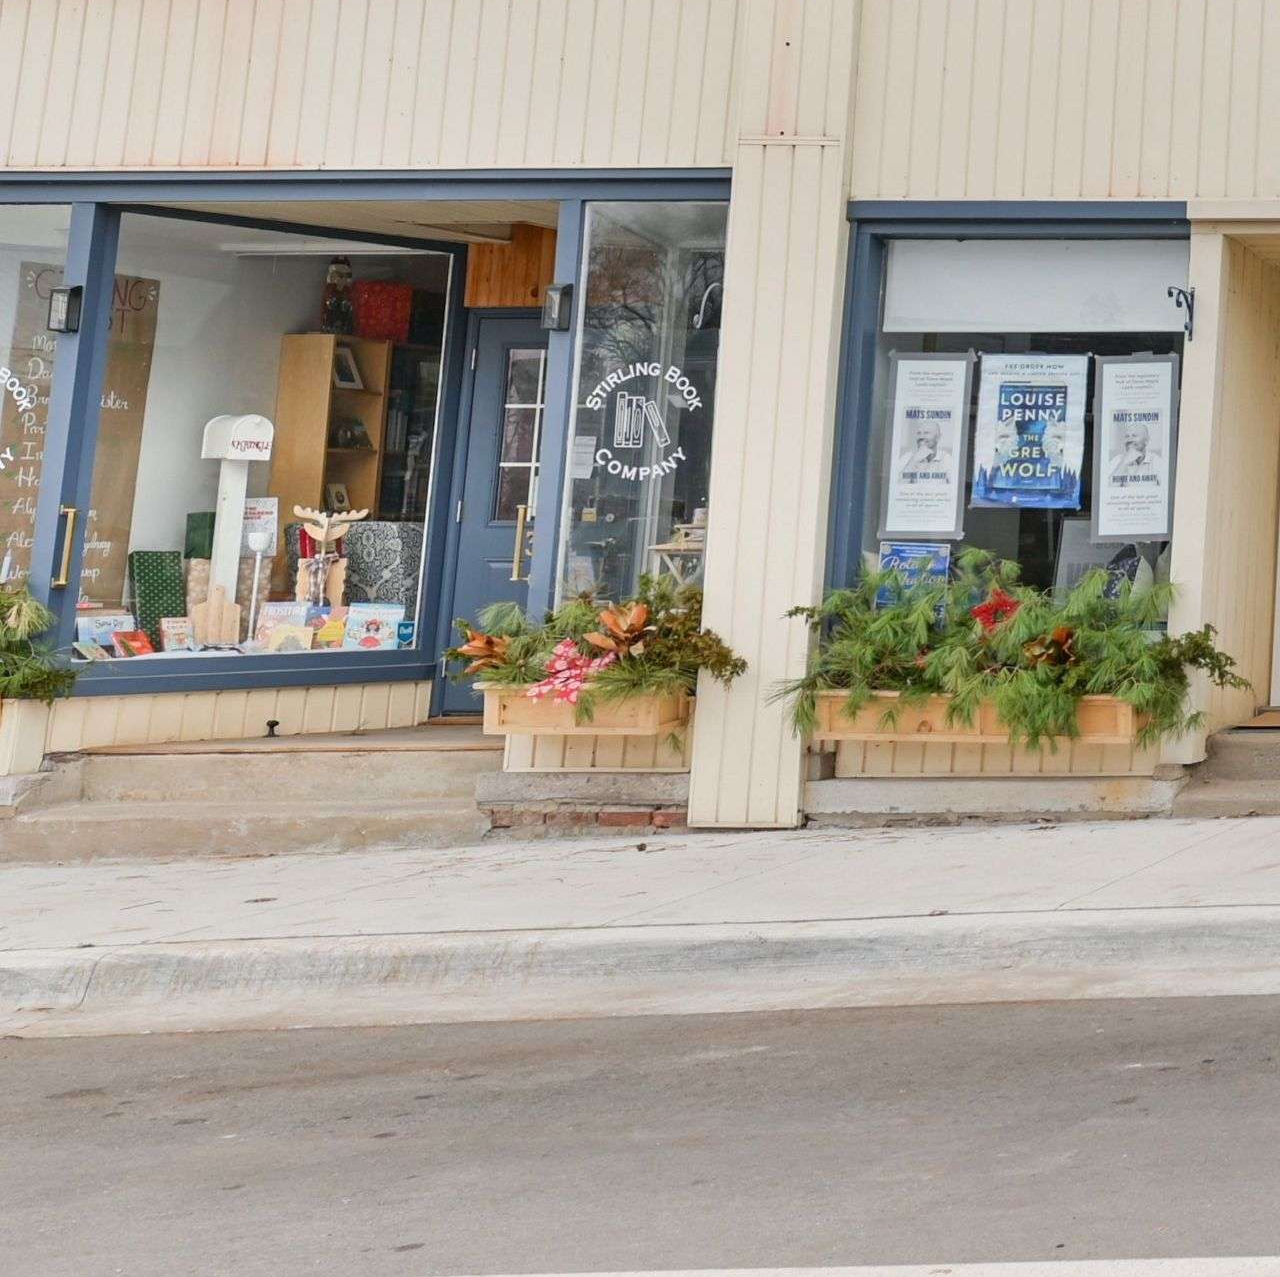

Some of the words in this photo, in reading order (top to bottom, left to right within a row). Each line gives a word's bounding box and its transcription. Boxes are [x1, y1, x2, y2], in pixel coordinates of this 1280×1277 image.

[585, 362, 661, 411] STIRLING
[664, 366, 703, 411] BOOK
[1001, 393, 1065, 406] LOUISE
[905, 409, 925, 420] MATS
[926, 409, 952, 420] SUNDIN
[1002, 408, 1063, 422] PENNY
[1113, 412, 1132, 422] MATS
[1133, 411, 1160, 422] SUNDIN
[1023, 434, 1040, 442] THE
[1008, 446, 1051, 458] GREY
[595, 446, 687, 480] COMPANY
[1000, 462, 1058, 477] WOLF
